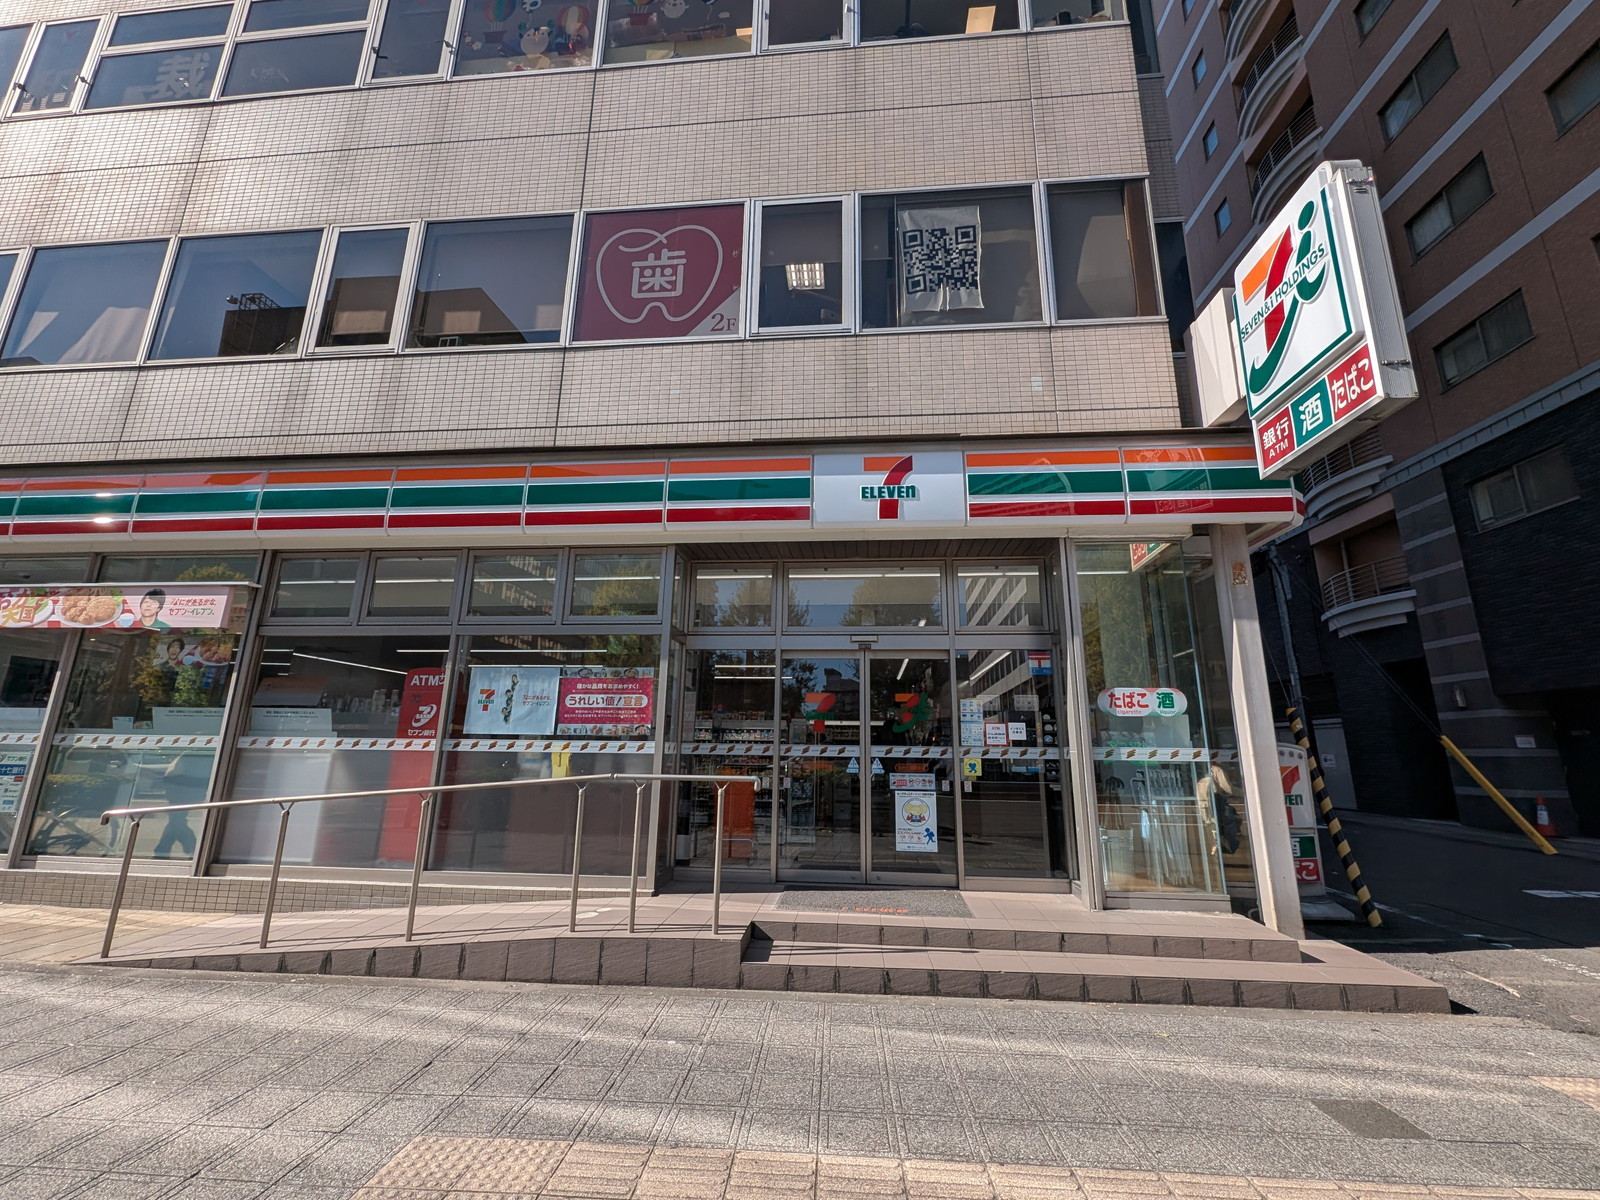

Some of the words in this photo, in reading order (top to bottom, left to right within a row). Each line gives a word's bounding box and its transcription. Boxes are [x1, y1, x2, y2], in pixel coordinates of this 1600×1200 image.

[631, 249, 687, 298] 歯
[1274, 243, 1325, 303] HOLDINGS
[710, 312, 737, 333] 2F
[1331, 358, 1374, 413] たばこ
[1298, 392, 1324, 436] 酒
[1262, 416, 1290, 450] 銀行
[1269, 438, 1289, 459] ATM
[1108, 691, 1149, 709] たばこ
[1156, 692, 1175, 709] 酒
[0, 766, 25, 774] 十七銀行
